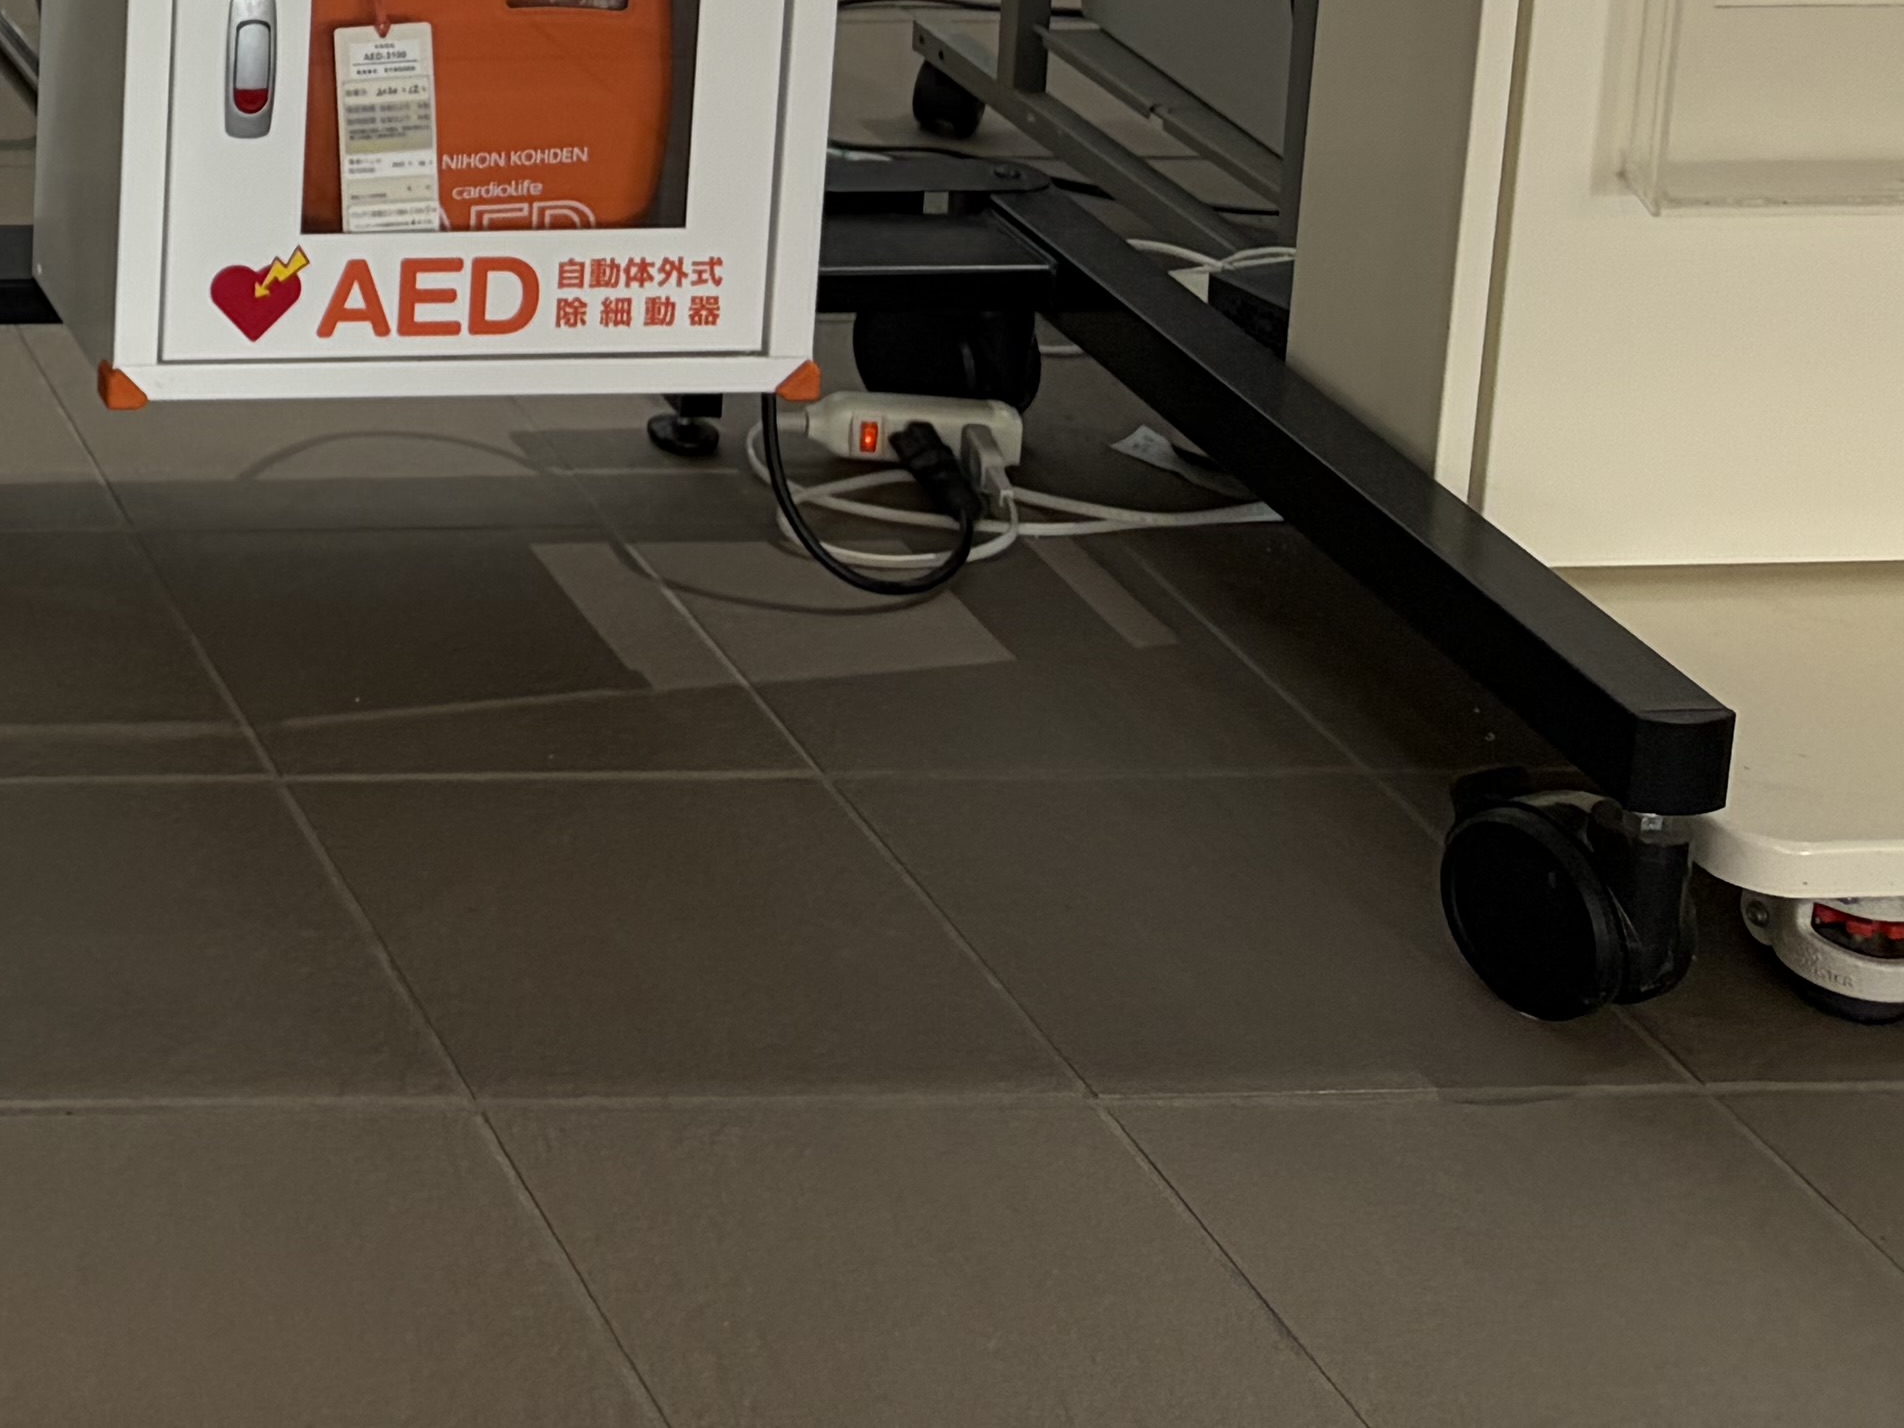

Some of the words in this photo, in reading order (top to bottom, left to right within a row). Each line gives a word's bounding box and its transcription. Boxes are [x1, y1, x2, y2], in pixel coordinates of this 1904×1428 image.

[442, 151, 506, 170] NIHON
[510, 146, 589, 167] KOHDEN
[557, 256, 726, 291] 自動体外式
[316, 254, 541, 339] AED
[554, 296, 723, 330] 除細動器
